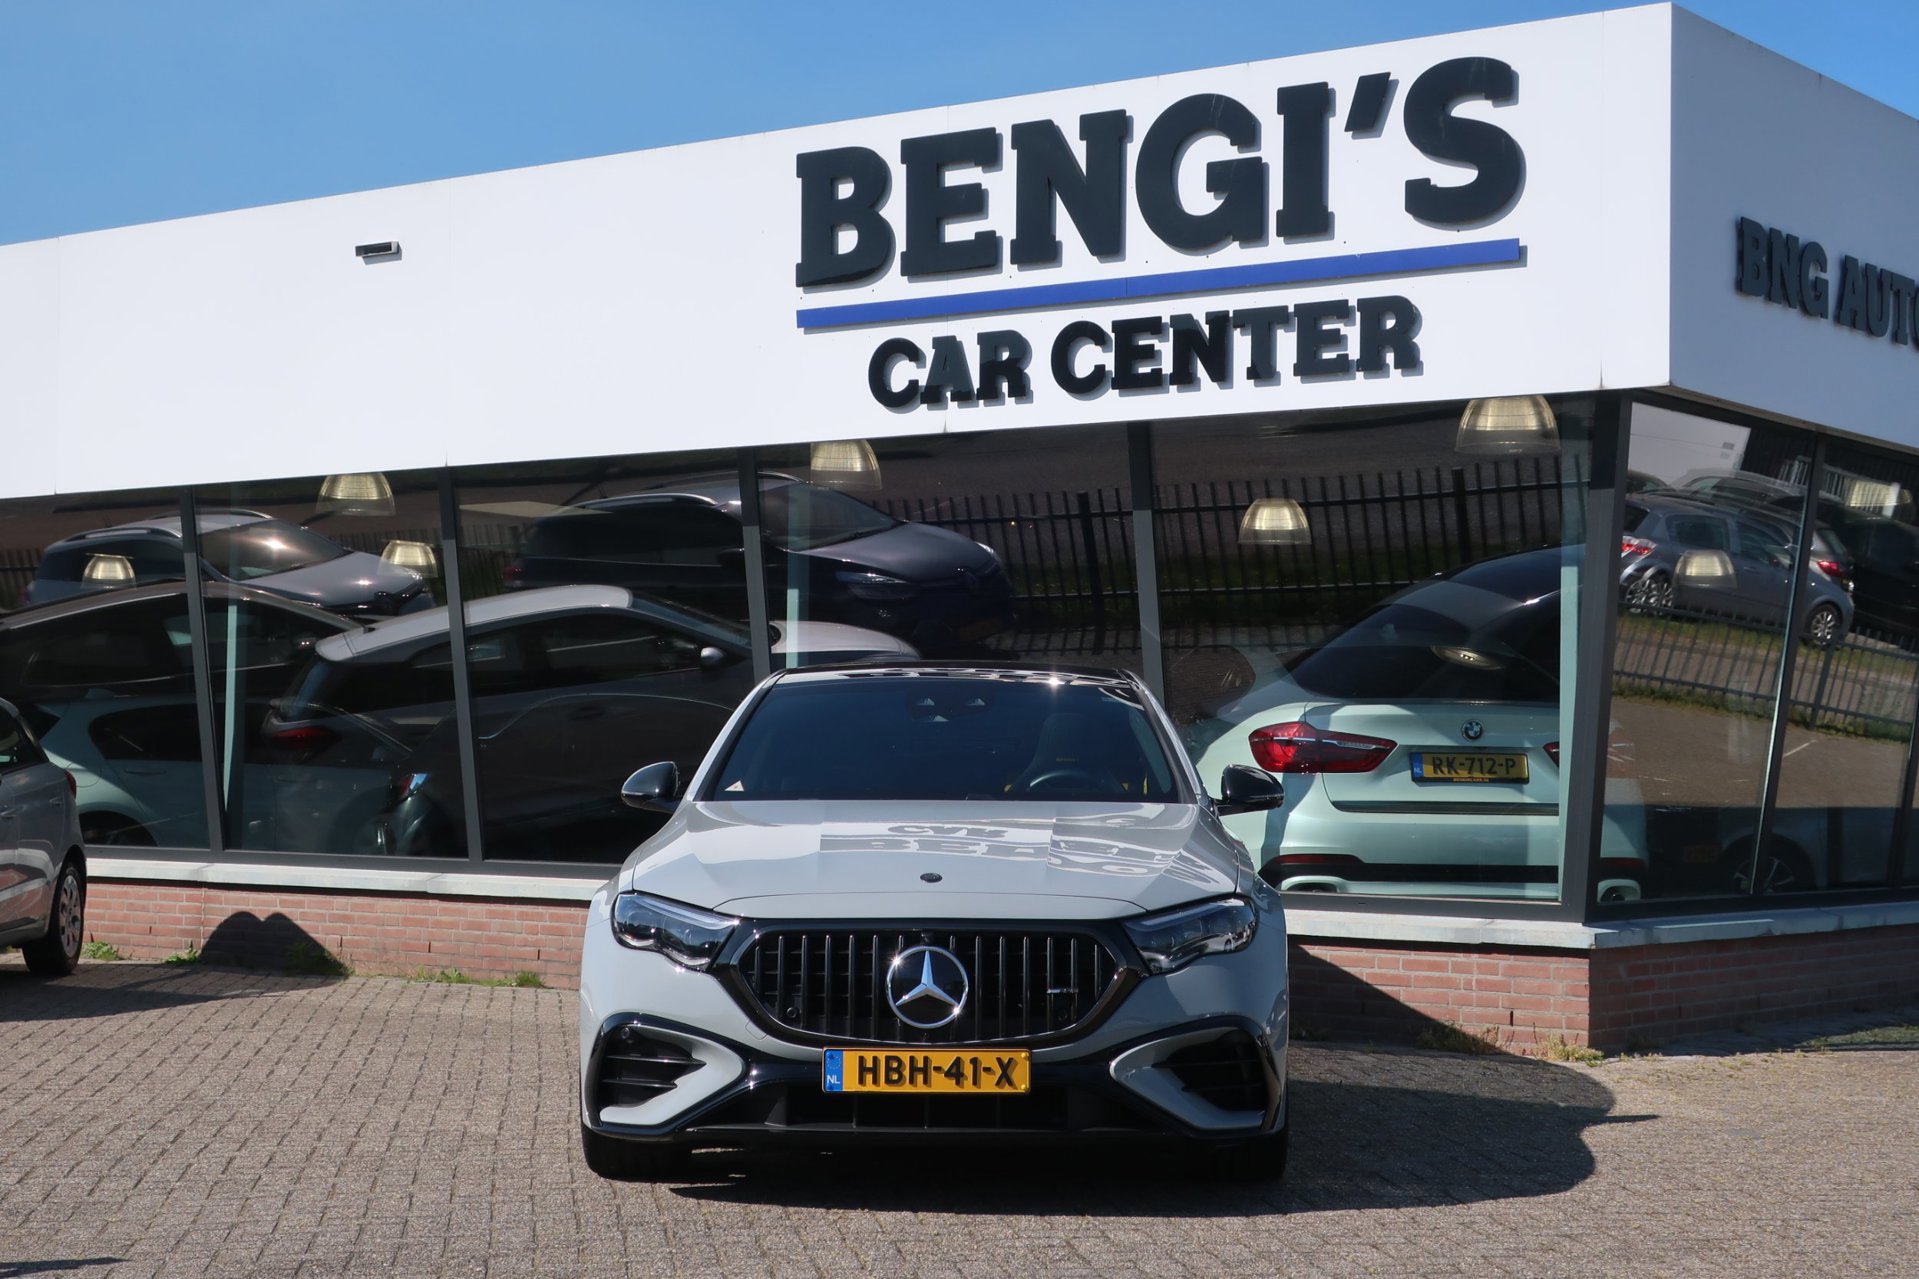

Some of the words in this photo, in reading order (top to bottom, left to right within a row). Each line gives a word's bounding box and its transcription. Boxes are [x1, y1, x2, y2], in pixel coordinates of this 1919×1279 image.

[796, 56, 1524, 289] BENGI'S
[1736, 216, 1829, 320] BNG
[1836, 254, 1919, 352] AUT
[868, 330, 1031, 409] CAR
[1051, 295, 1422, 396] CENTER
[1431, 756, 1517, 776] RK-712-P
[826, 1075, 841, 1085] NL
[857, 1055, 1016, 1087] HBH-41-X
